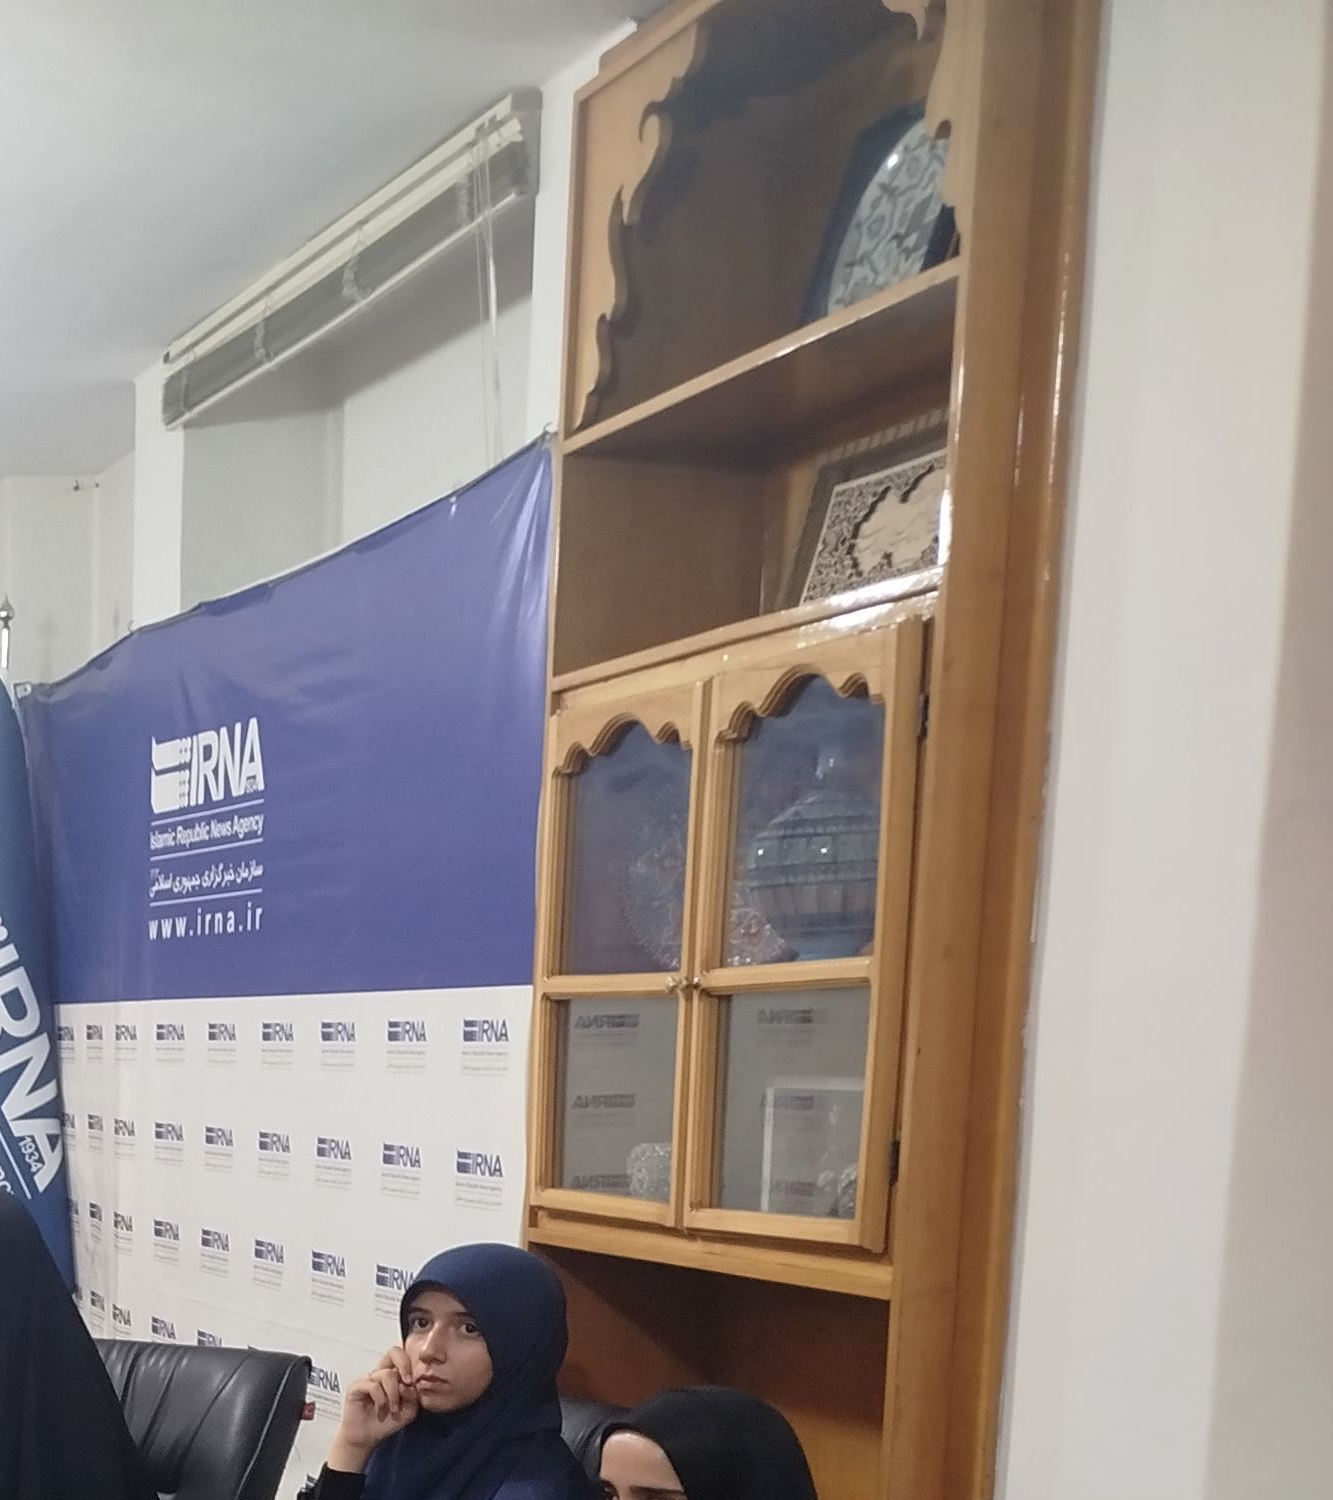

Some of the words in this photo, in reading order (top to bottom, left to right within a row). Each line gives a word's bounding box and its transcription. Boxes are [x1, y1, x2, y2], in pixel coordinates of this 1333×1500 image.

[190, 717, 265, 806] IRNA
[210, 819, 231, 839] News
[232, 814, 264, 839] Agency
[149, 901, 263, 940] www.irna.ir
[400, 1020, 427, 1043] IRNA
[479, 1019, 510, 1043] IRNA
[18, 1136, 44, 1172] 1934
[395, 1144, 422, 1169] IRNA
[472, 1152, 504, 1179] IRNA
